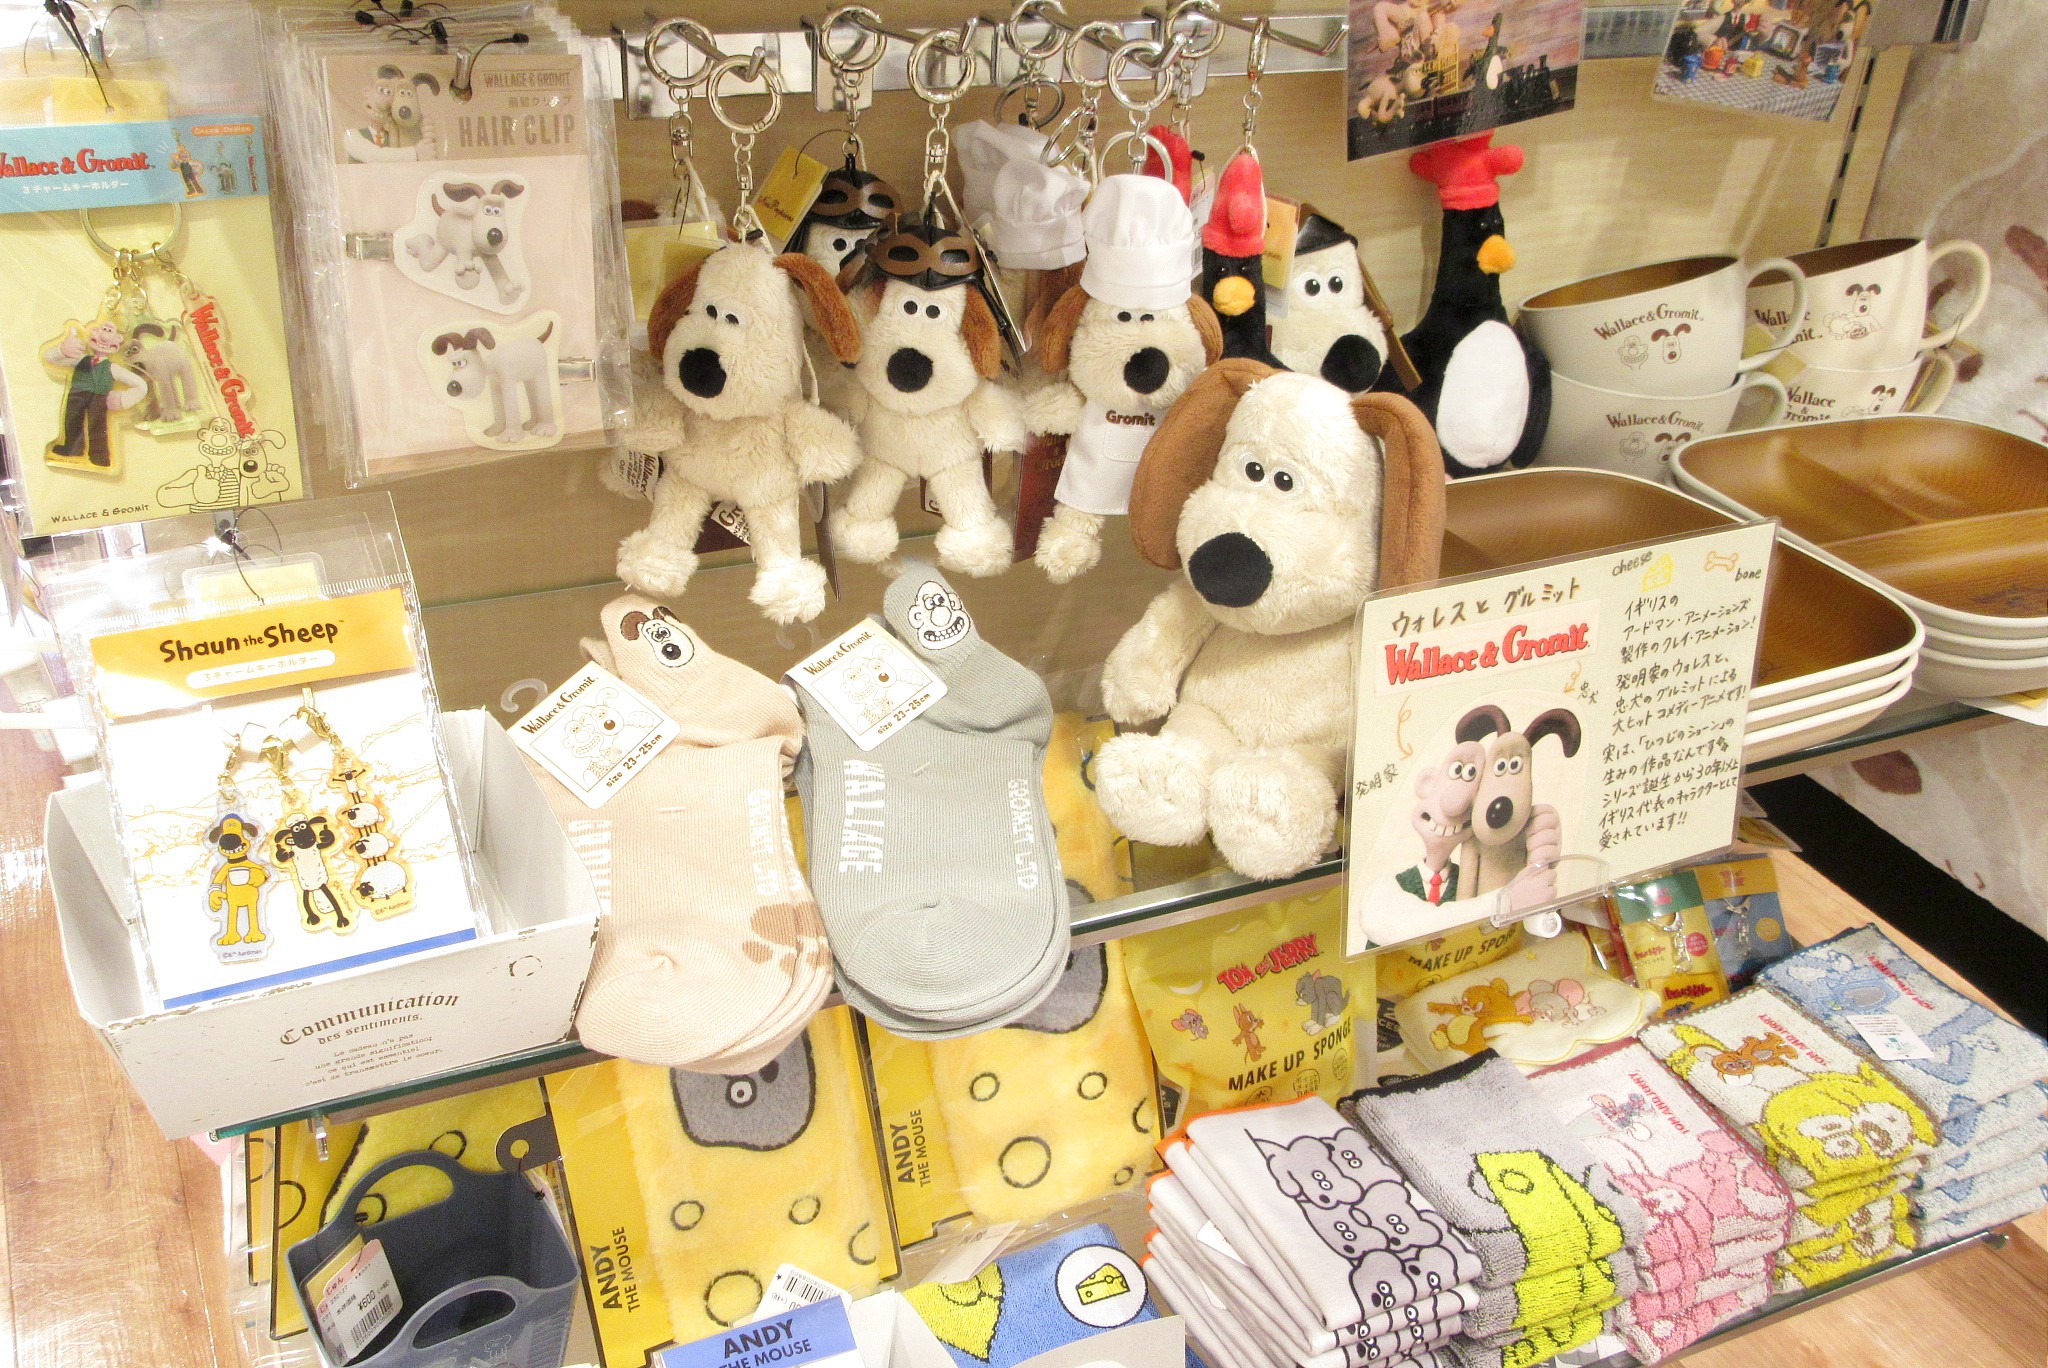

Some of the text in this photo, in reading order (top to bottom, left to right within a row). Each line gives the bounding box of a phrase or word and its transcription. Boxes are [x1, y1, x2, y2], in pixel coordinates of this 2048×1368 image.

[460, 114, 575, 147] HAIR CLIP
[60, 156, 77, 174] &
[77, 148, 151, 174] Gromit
[1594, 303, 1700, 340] Wallace & Gromit
[190, 301, 224, 369] Wallace
[221, 378, 256, 439] Gromit
[1105, 409, 1156, 427] Gromit
[1606, 413, 1658, 429] Wallace
[1612, 550, 1653, 577] cheese
[1734, 568, 1762, 583] bone
[159, 622, 339, 663] Shaun the Sheep
[802, 655, 839, 676] Wallace
[839, 631, 873, 654] Gromit
[1385, 623, 1589, 685] Wallace & Gromit
[520, 703, 560, 736] Wallace
[559, 675, 596, 705] Gromit
[877, 721, 894, 735] size
[606, 771, 624, 788] size
[1217, 961, 1256, 994] TOM
[1268, 932, 1320, 974] JERRY
[1408, 952, 1451, 973] MAKE
[1454, 944, 1473, 963] UP
[280, 991, 460, 1045] Communication
[317, 1012, 424, 1046] des sentiments.
[1228, 1060, 1278, 1092] MAKE
[1283, 1049, 1305, 1073] UP
[1313, 1016, 1351, 1061] SPONGE
[1758, 1013, 1830, 1067] TOM AND JERRY
[1628, 1072, 1690, 1135] TOM AND JERRY
[889, 1123, 916, 1184] ANDY
[910, 1109, 931, 1188] THE MOUSE
[590, 1245, 623, 1309] ANDY
[612, 1226, 641, 1313] THE MOUSE
[357, 1289, 376, 1311] ¥600
[724, 1318, 793, 1360] ANDY
[754, 1339, 812, 1367] MOUSE
